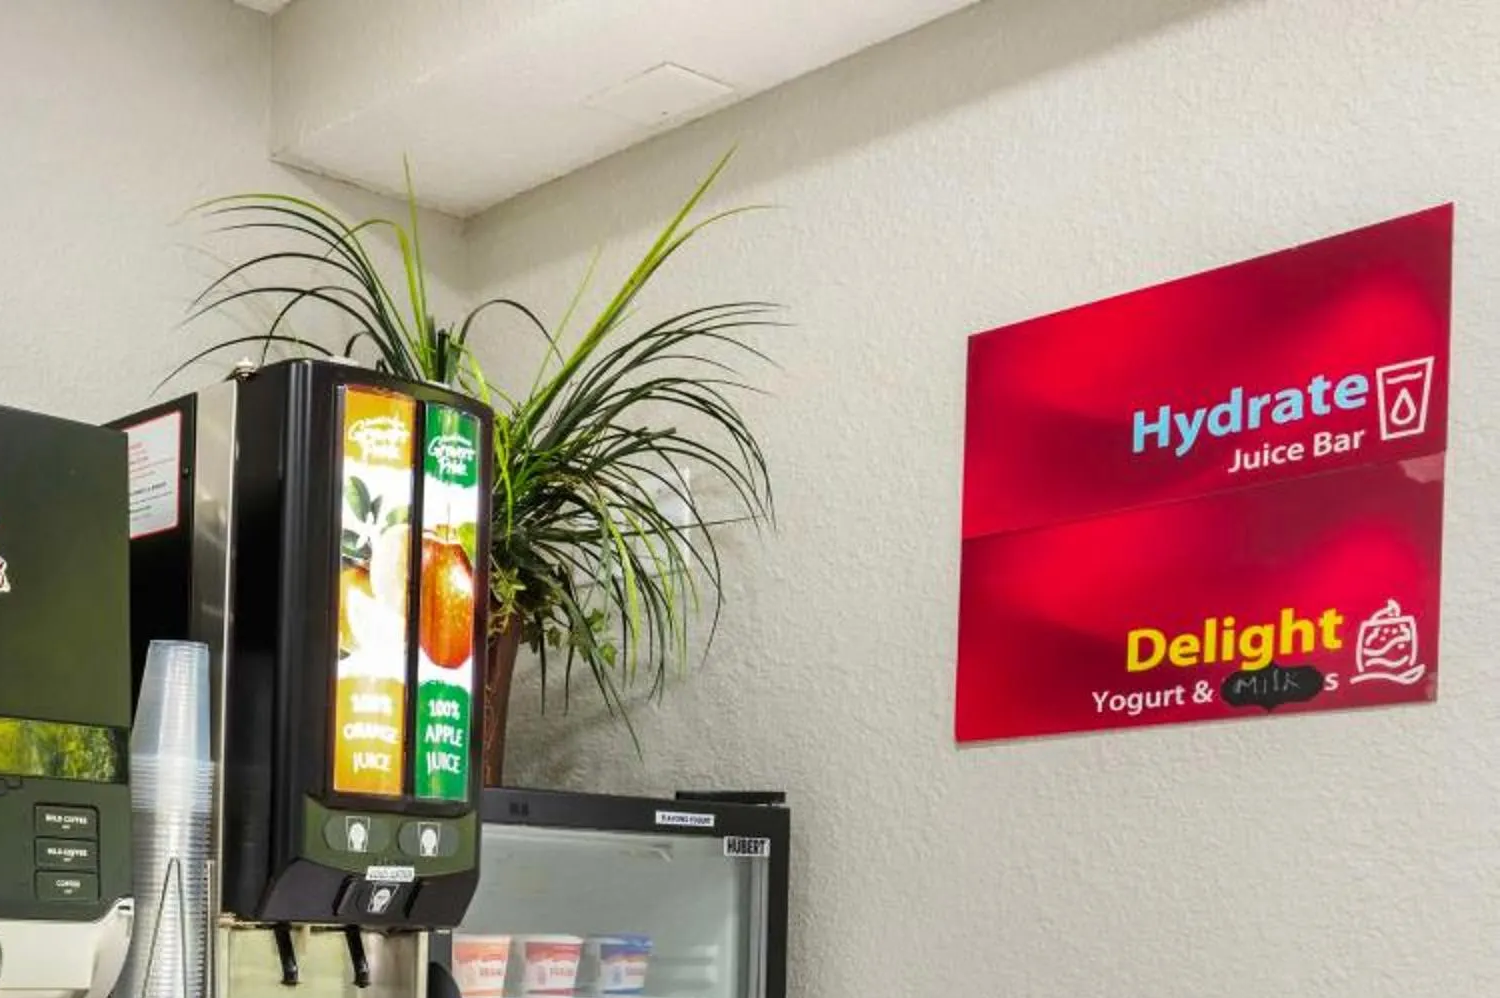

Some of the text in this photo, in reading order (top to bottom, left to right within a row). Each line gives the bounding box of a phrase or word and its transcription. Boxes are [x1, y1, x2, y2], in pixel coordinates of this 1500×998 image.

[1132, 373, 1369, 457] Hydrate
[1228, 429, 1366, 474] Juice Bar
[1126, 607, 1343, 673] Delight
[428, 699, 460, 720] 100%
[1091, 680, 1214, 716] Yogurt &
[343, 721, 400, 744] ORANGE
[424, 724, 463, 747] APPLE
[352, 751, 391, 774] JUICE
[426, 751, 461, 775] JUICE
[726, 838, 765, 855] HUBERT
